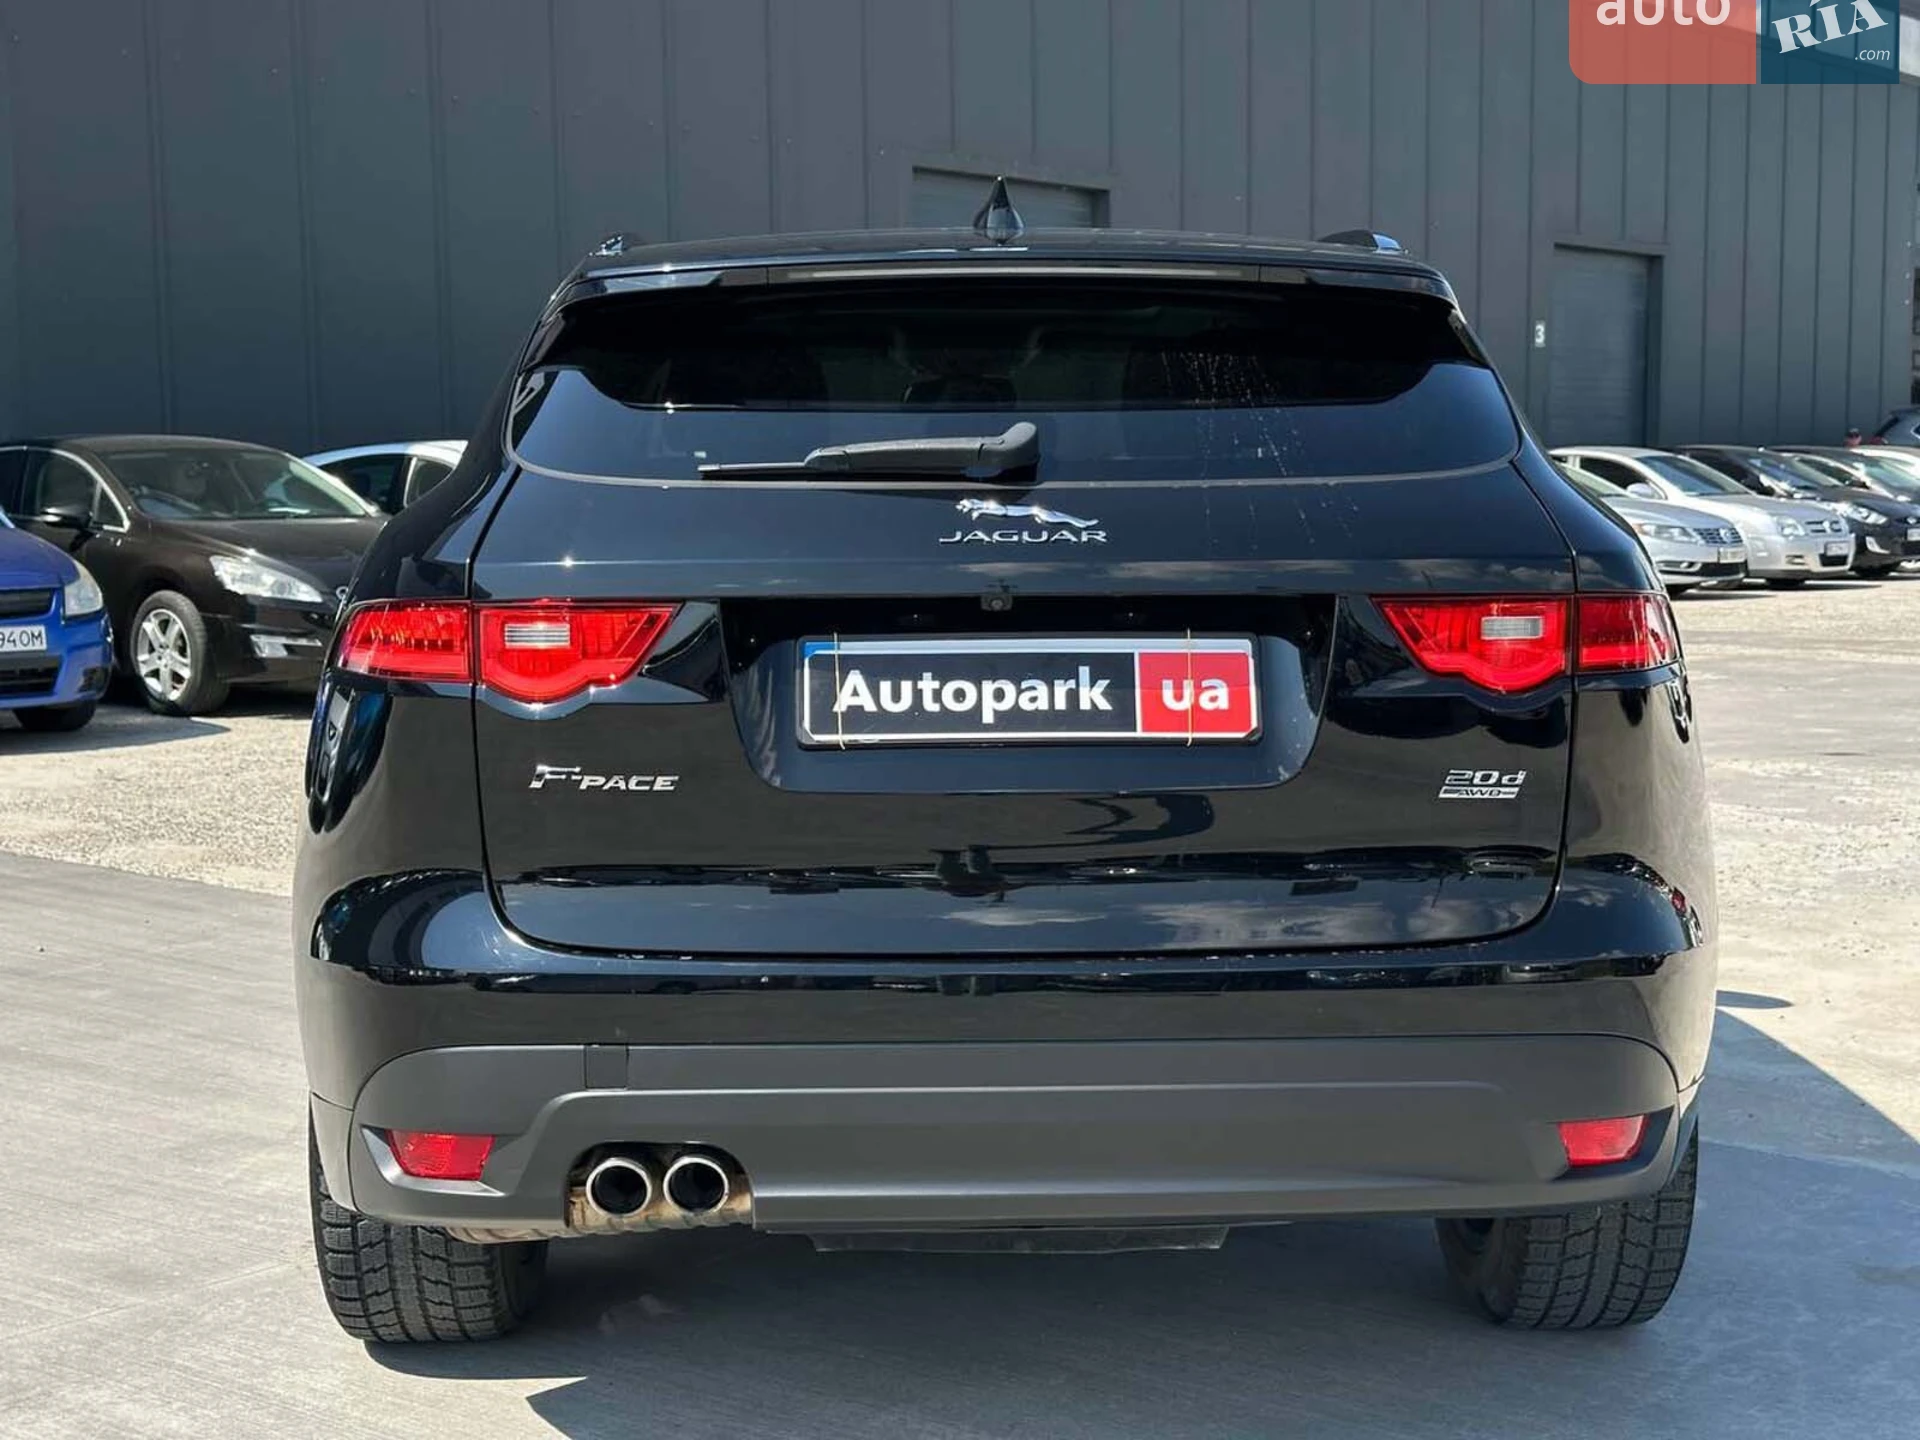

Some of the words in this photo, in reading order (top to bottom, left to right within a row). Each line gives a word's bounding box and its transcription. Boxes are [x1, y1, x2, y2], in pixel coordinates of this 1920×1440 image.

[1535, 324, 1545, 343] 3
[939, 530, 1108, 544] JAGUAR
[832, 666, 1113, 724] Autopark
[1162, 678, 1229, 711] ua
[529, 764, 680, 791] F-PACE
[1445, 769, 1527, 785] 20d
